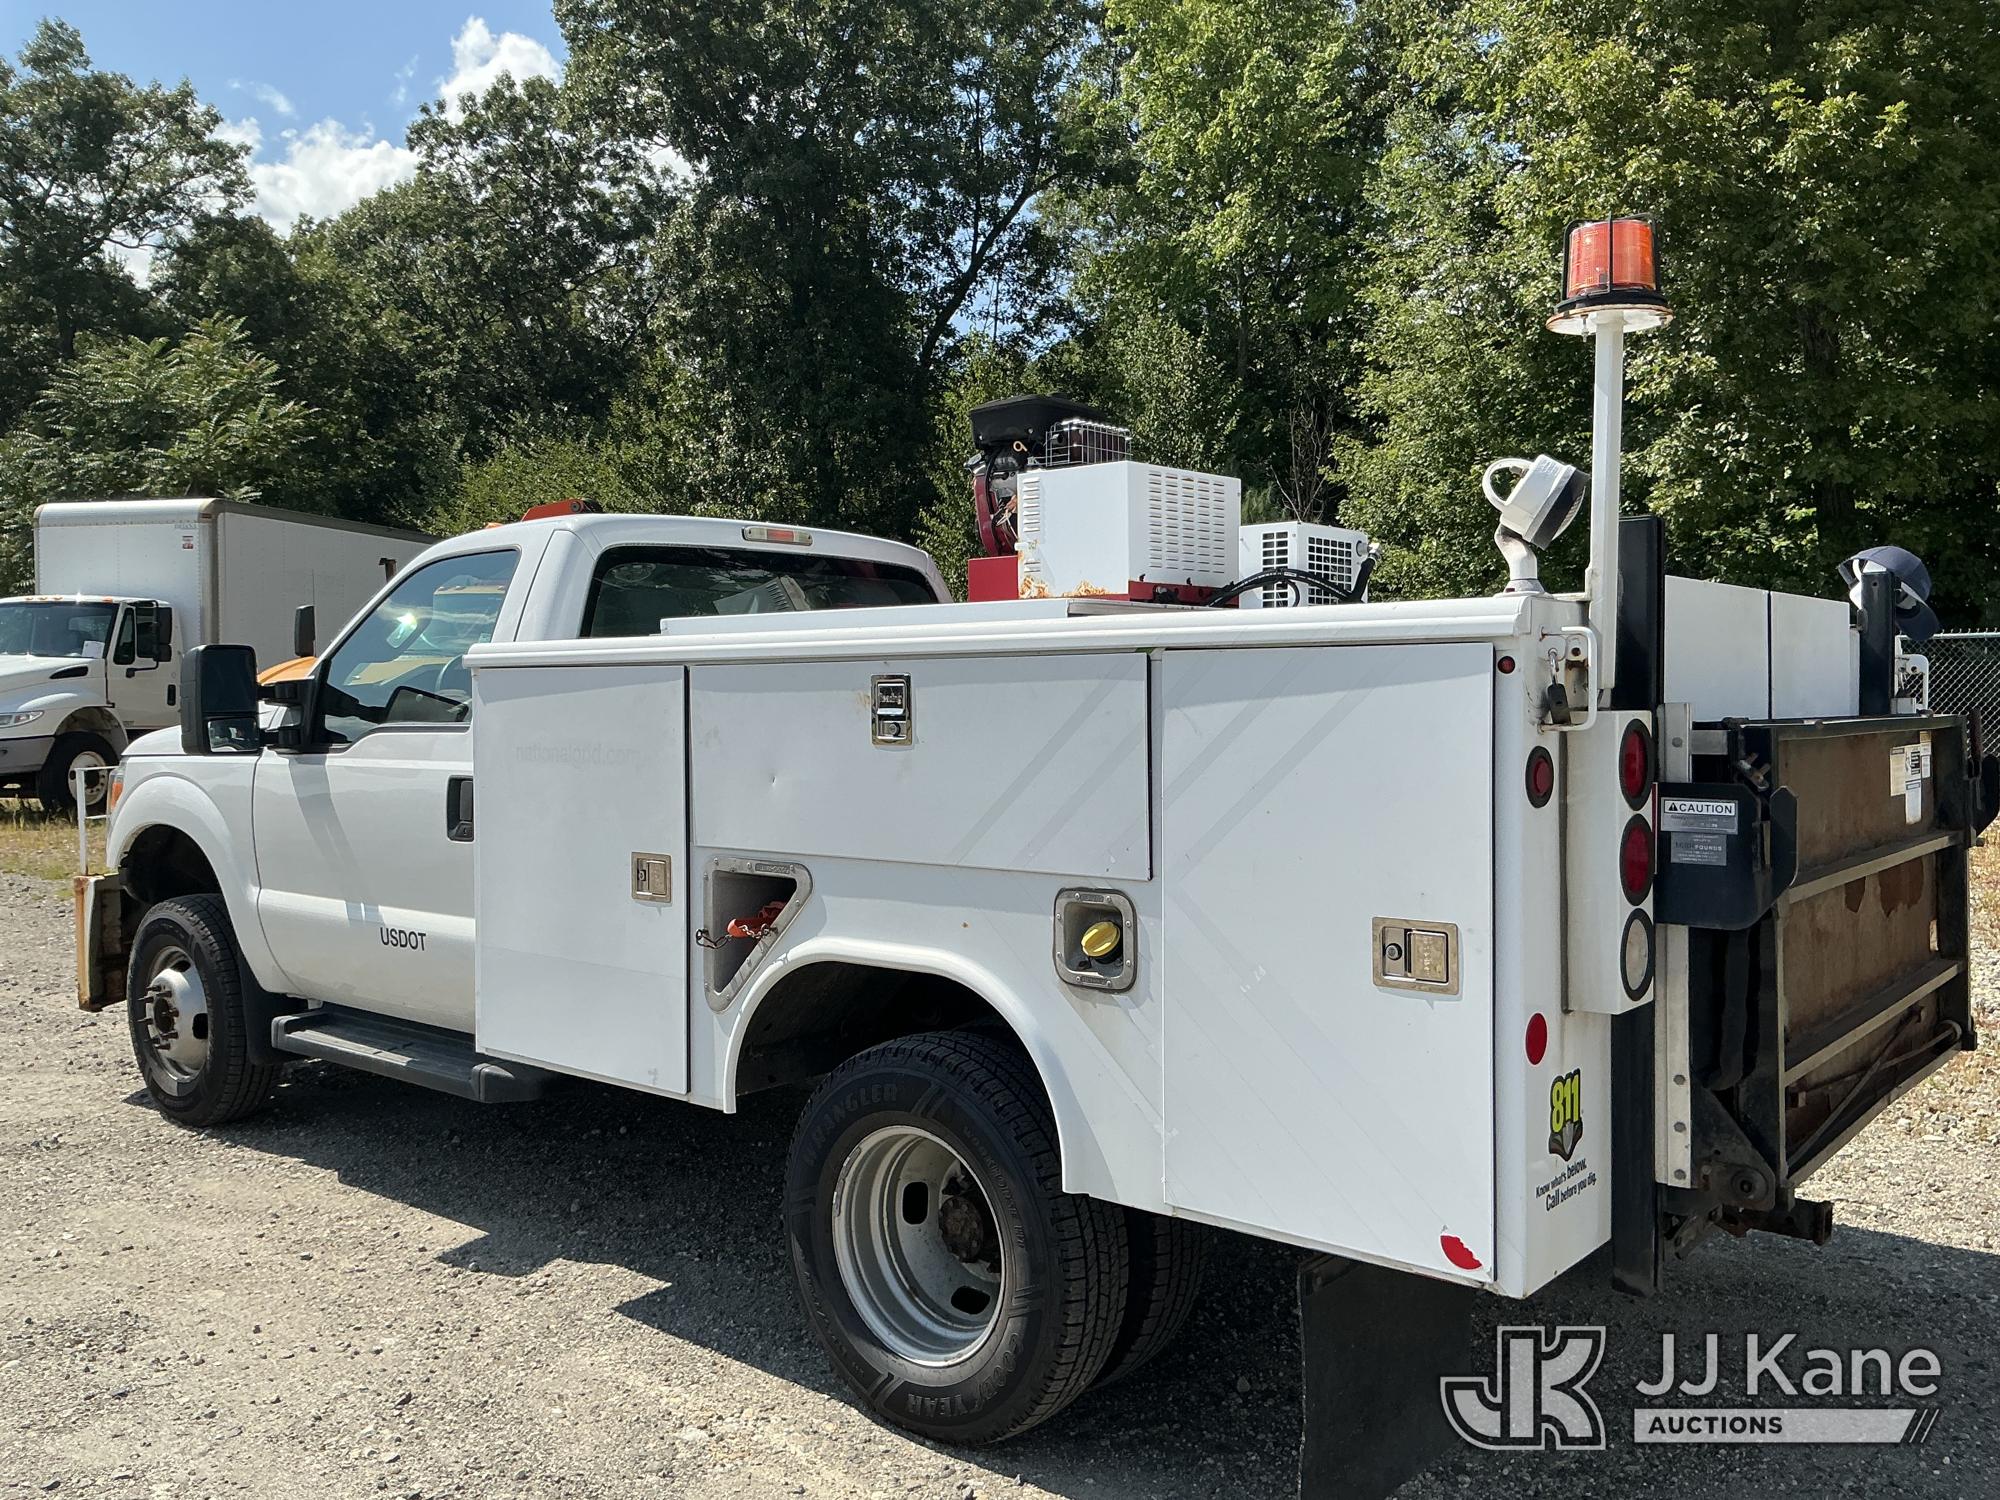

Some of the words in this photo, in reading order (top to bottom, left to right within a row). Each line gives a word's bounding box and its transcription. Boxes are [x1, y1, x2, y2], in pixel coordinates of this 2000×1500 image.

[1679, 803, 1733, 814] CAUTION
[380, 927, 426, 951] USDOT
[1550, 1069, 1581, 1133] 811
[1535, 1183, 1551, 1199] Know
[1545, 1188, 1560, 1212] Call
[1560, 1181, 1577, 1203] before
[1577, 1178, 1587, 1196] you
